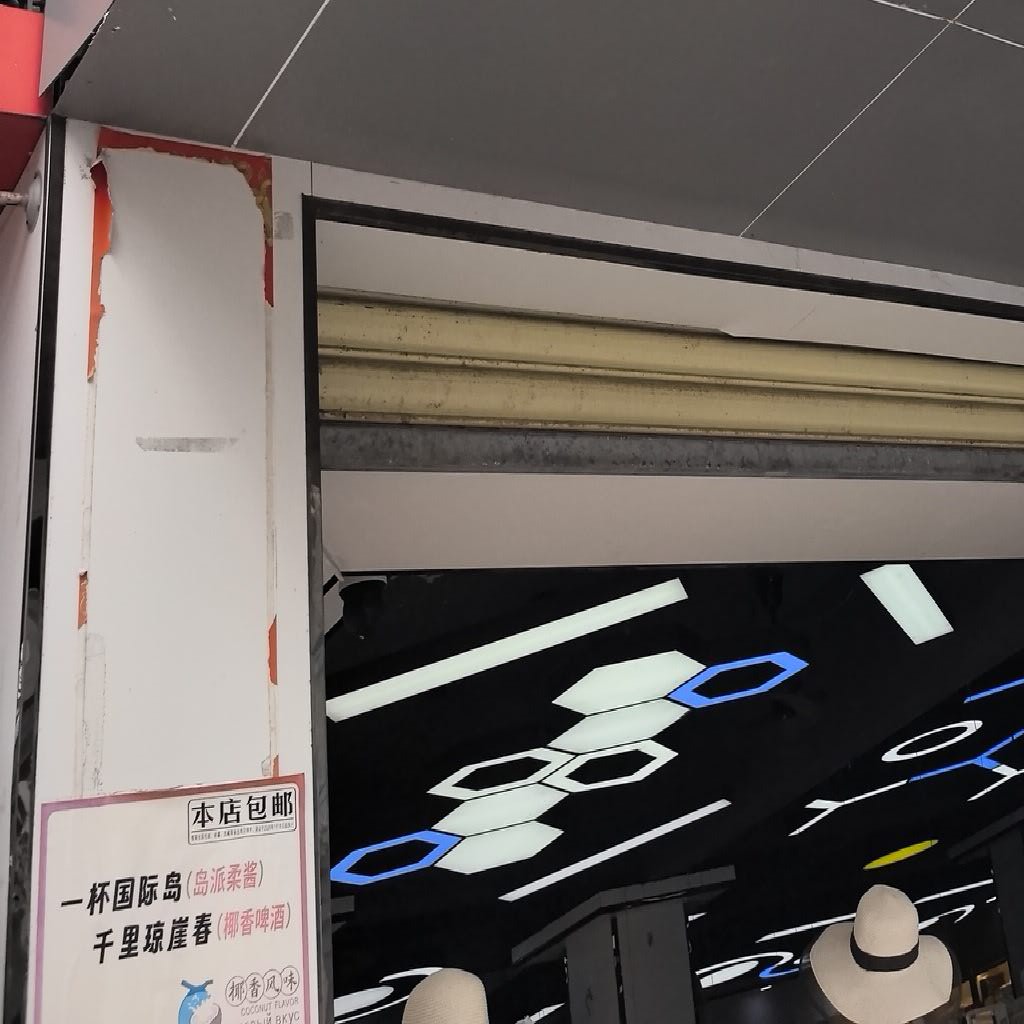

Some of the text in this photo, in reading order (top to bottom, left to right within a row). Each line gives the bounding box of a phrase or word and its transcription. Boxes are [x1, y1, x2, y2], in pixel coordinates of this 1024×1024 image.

[191, 791, 293, 828] 本店包邮
[228, 970, 297, 1002] 椰香风味
[241, 997, 299, 1017] COCONUT FLAVOR
